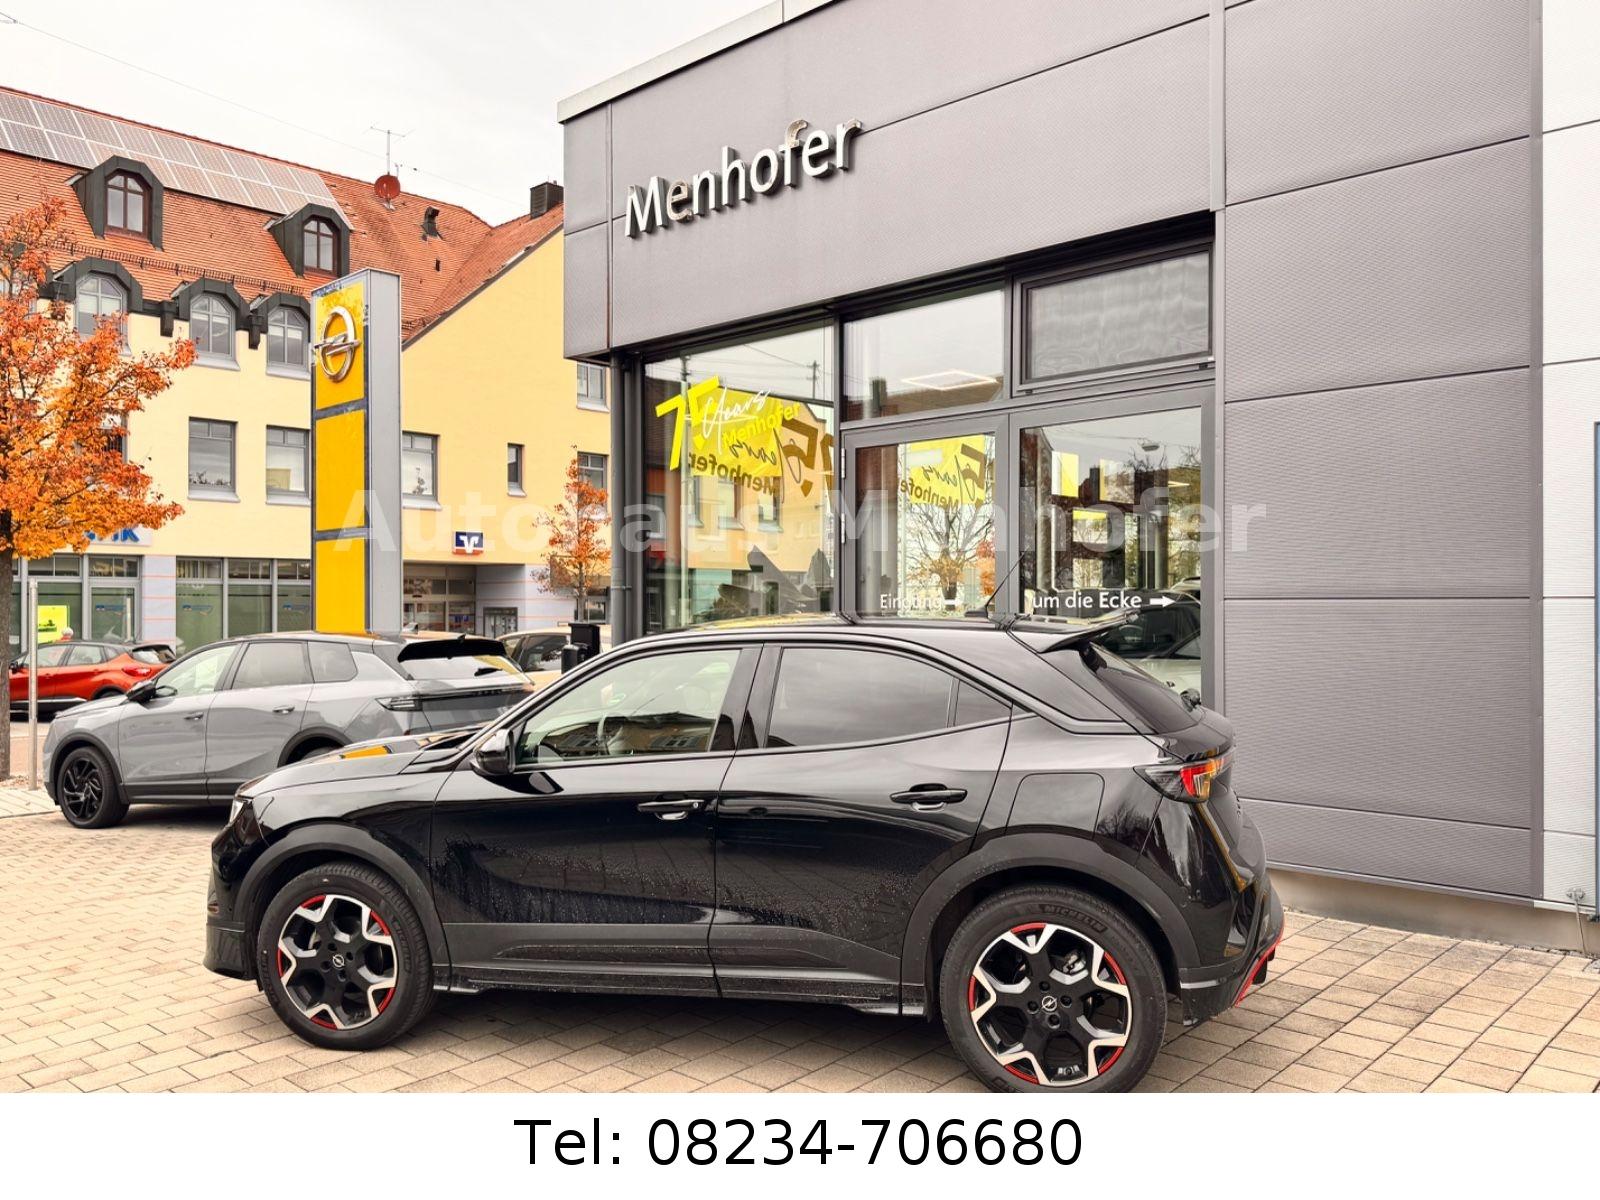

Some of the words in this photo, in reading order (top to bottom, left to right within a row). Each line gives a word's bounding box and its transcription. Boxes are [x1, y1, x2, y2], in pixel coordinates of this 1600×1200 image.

[624, 118, 862, 238] Menhofer
[721, 402, 802, 450] Menhofer
[1033, 596, 1060, 609] um
[1064, 591, 1094, 609] die
[1099, 590, 1143, 609] Ecke
